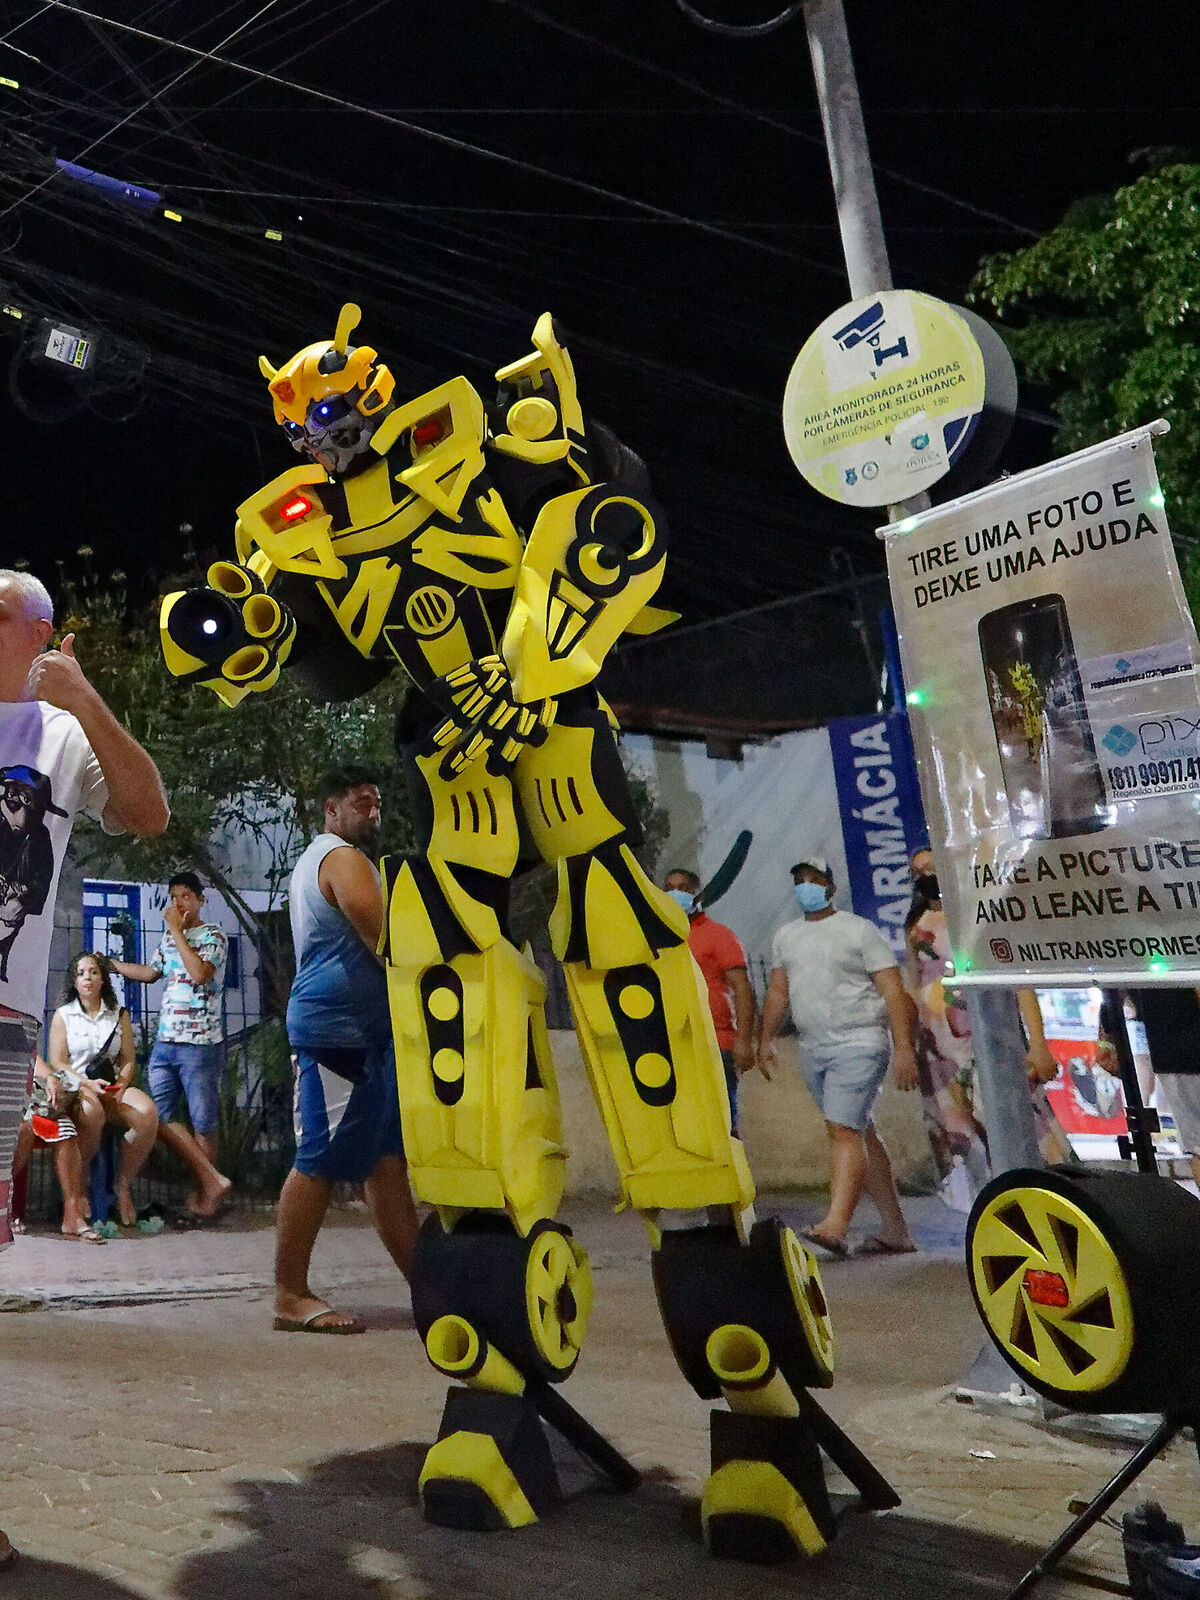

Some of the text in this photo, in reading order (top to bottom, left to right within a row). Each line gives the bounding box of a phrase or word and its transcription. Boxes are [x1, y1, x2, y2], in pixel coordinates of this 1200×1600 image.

[832, 383, 905, 415] MONITORADA
[906, 377, 918, 390] 24
[920, 361, 961, 383] HORAS
[803, 424, 824, 439] POR
[879, 400, 893, 412] DE
[907, 479, 1136, 576] TIRE UMA FOTO E
[914, 512, 1159, 608] DEIXE UMA AJUDA
[850, 721, 913, 953] FARMÁCIA
[1037, 855, 1058, 882] A
[1059, 839, 1200, 879] PICTURE
[976, 881, 1200, 924] AND LEAVE A TI
